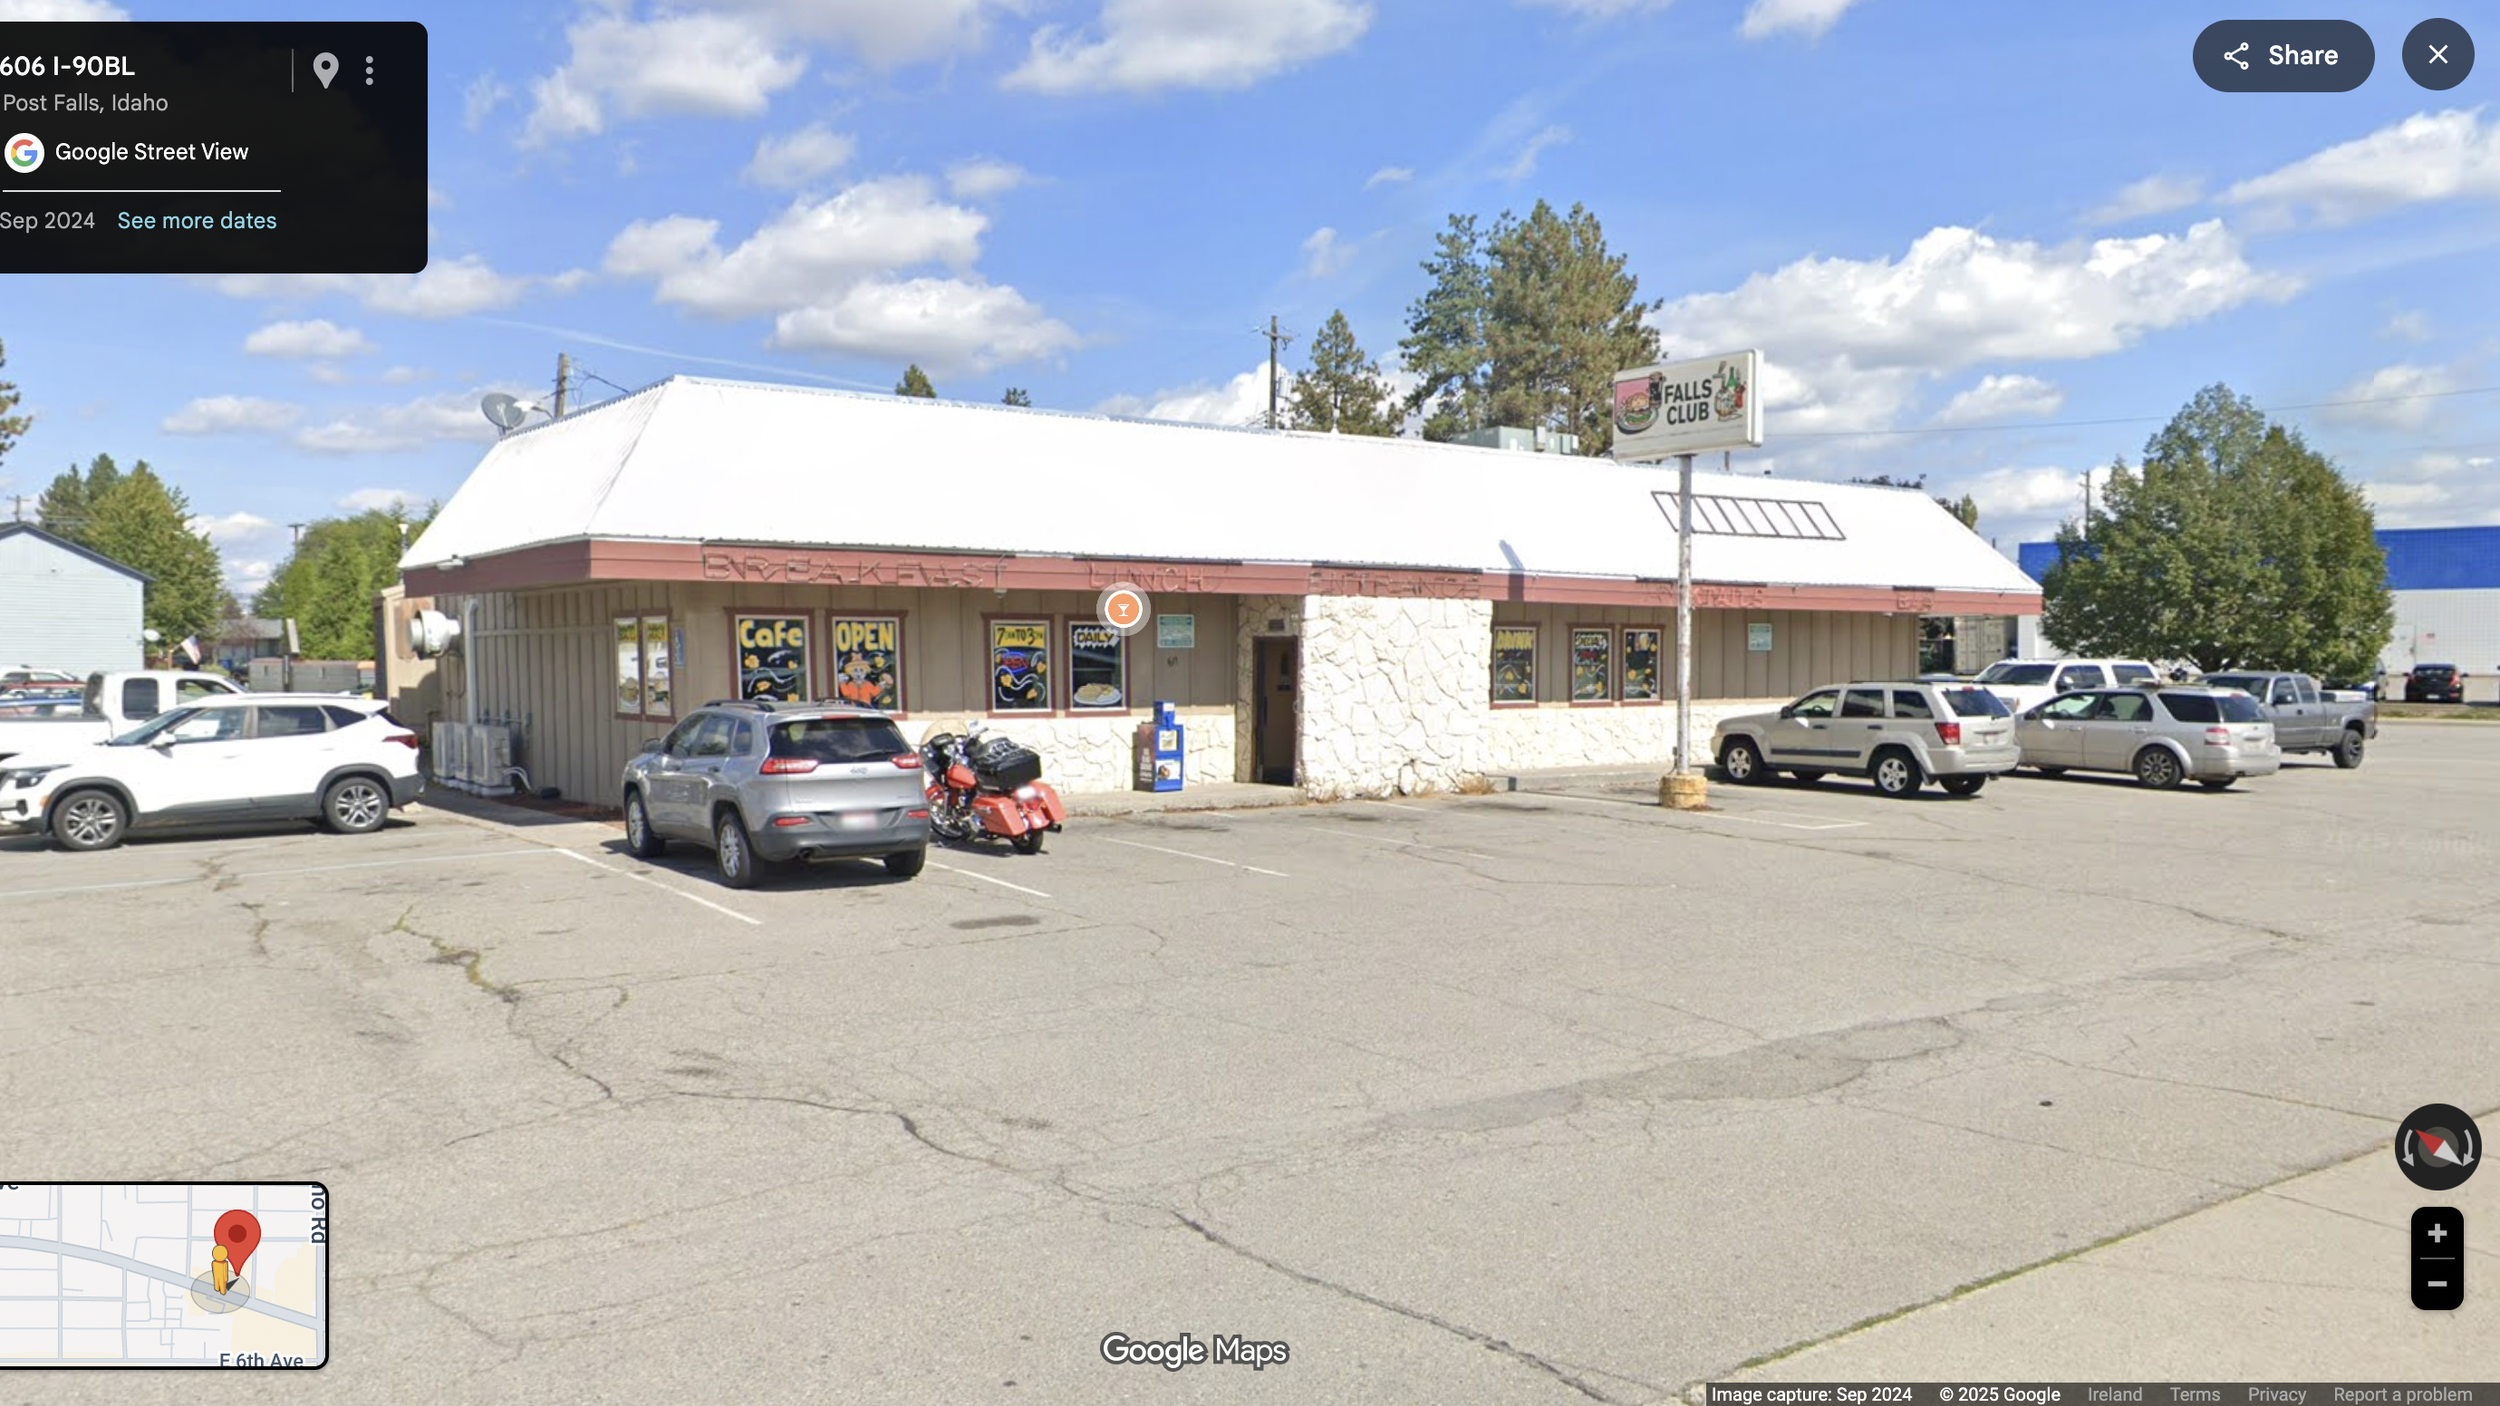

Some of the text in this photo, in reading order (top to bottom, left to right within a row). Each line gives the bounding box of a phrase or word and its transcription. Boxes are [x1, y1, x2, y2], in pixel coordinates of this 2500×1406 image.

[1665, 379, 1713, 404] FALLS
[1667, 402, 1710, 426] CLUB
[703, 551, 1007, 588] BREAKFAST
[739, 620, 804, 649] Cafe
[836, 621, 895, 652] OPEN
[1077, 631, 1115, 644] DAILY
